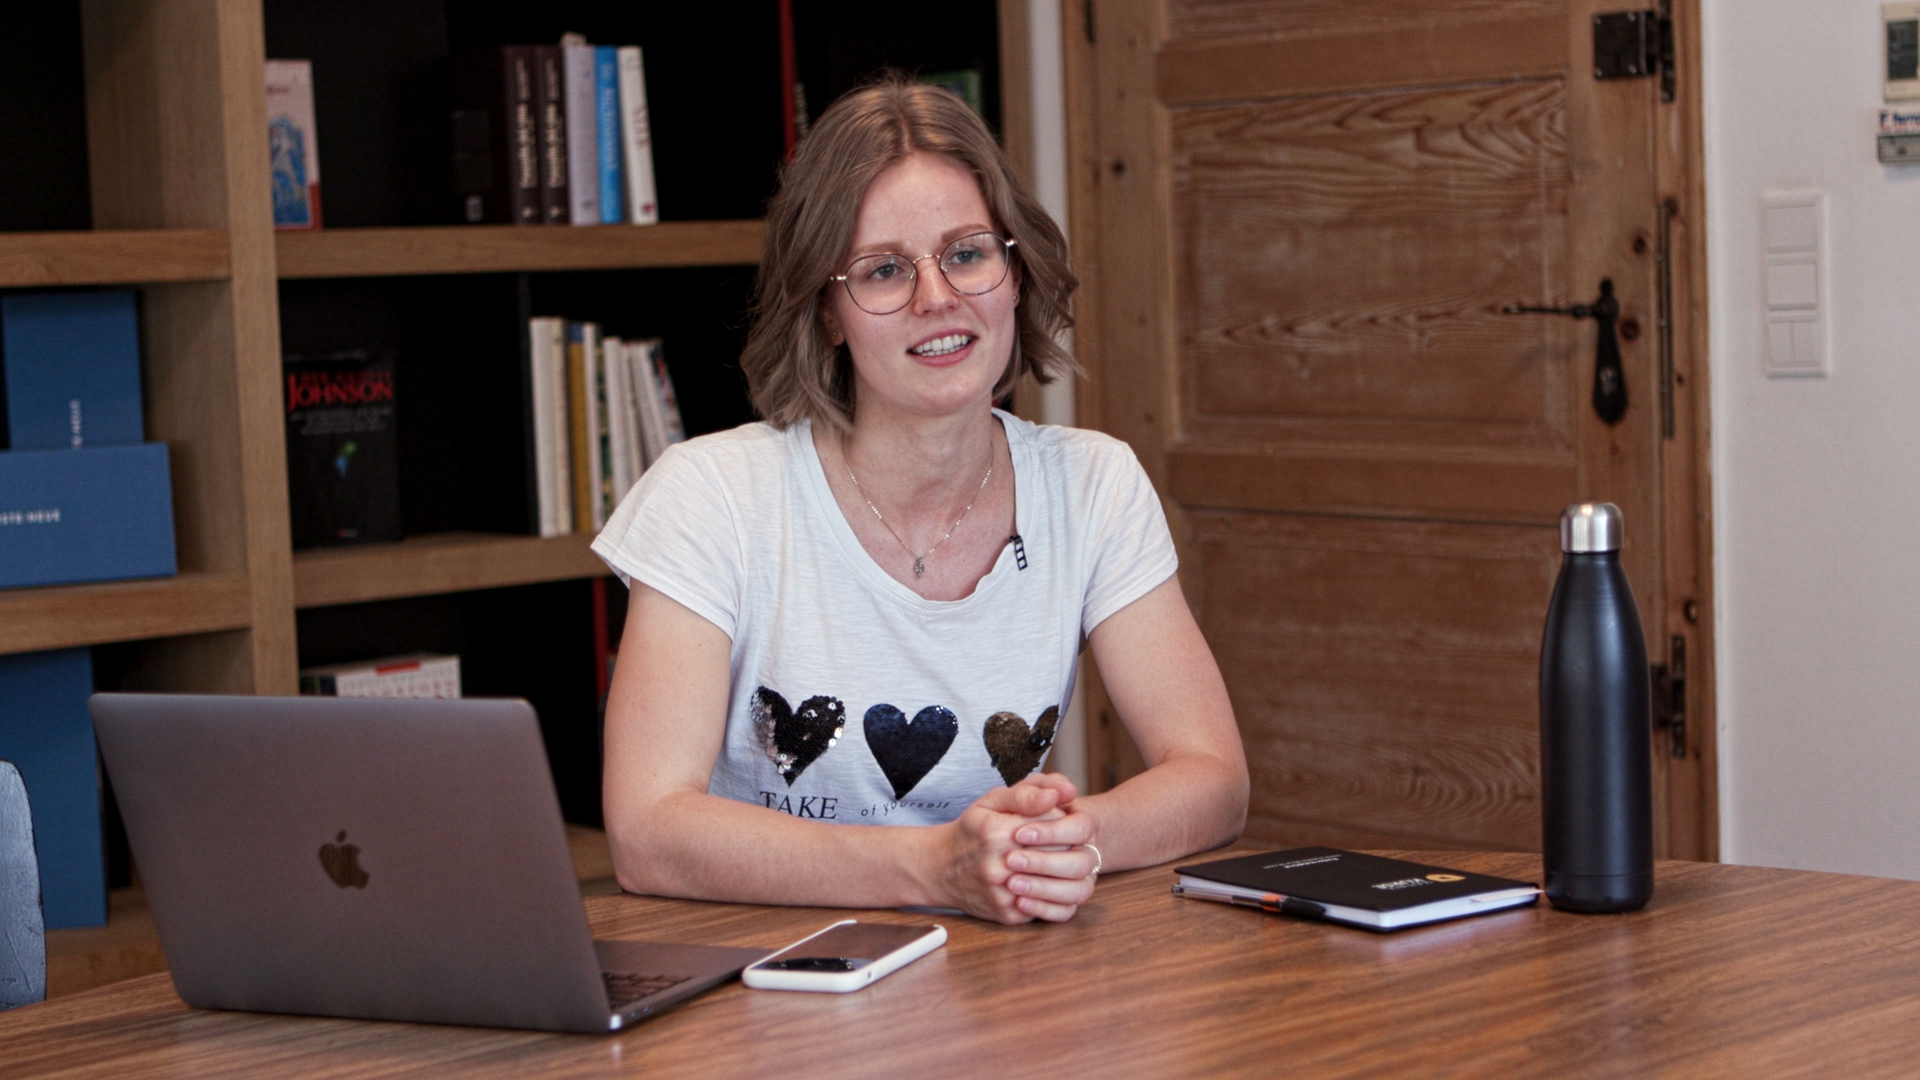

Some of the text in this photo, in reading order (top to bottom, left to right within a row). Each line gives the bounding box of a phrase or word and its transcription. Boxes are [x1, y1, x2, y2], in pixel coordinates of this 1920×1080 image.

[759, 791, 839, 820] TAKE
[861, 800, 951, 817] of yourself
